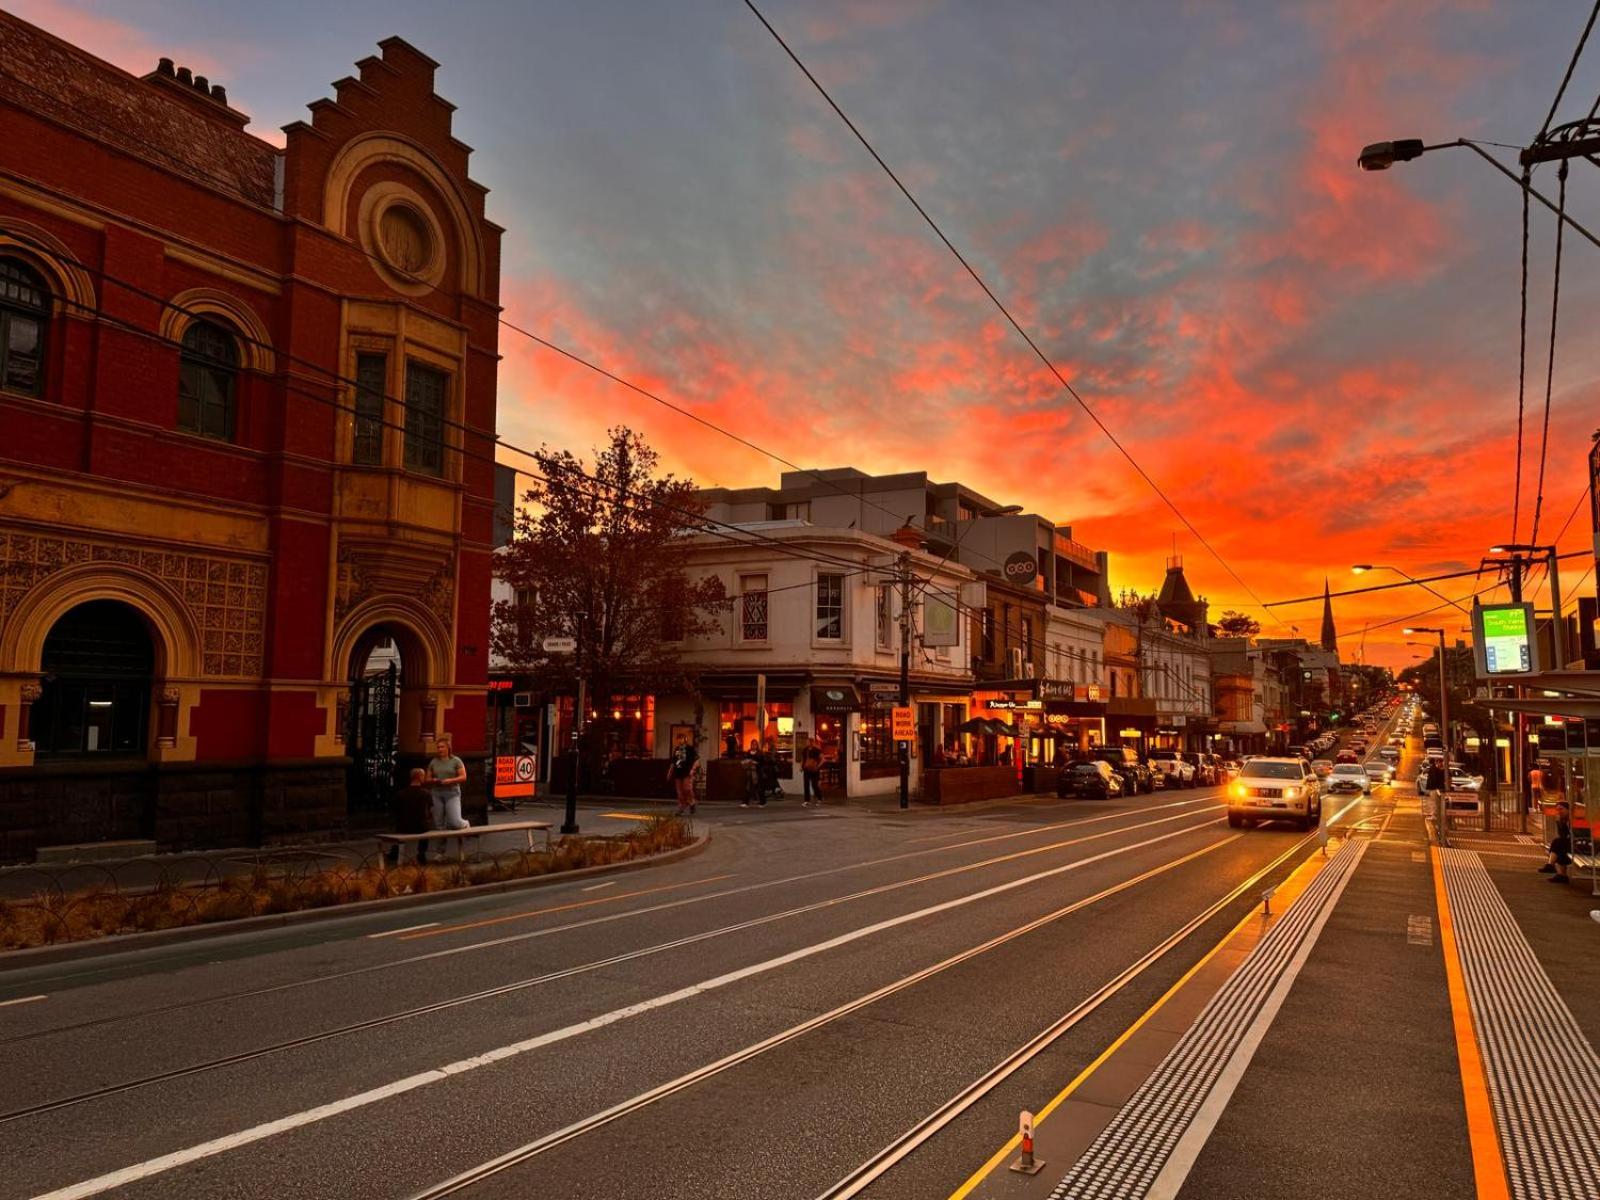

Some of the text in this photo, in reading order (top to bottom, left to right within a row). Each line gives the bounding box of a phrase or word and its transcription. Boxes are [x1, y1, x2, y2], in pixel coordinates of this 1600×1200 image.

[895, 711, 911, 719] ROAD
[895, 729, 914, 737] AHEAD
[520, 762, 532, 775] 40
